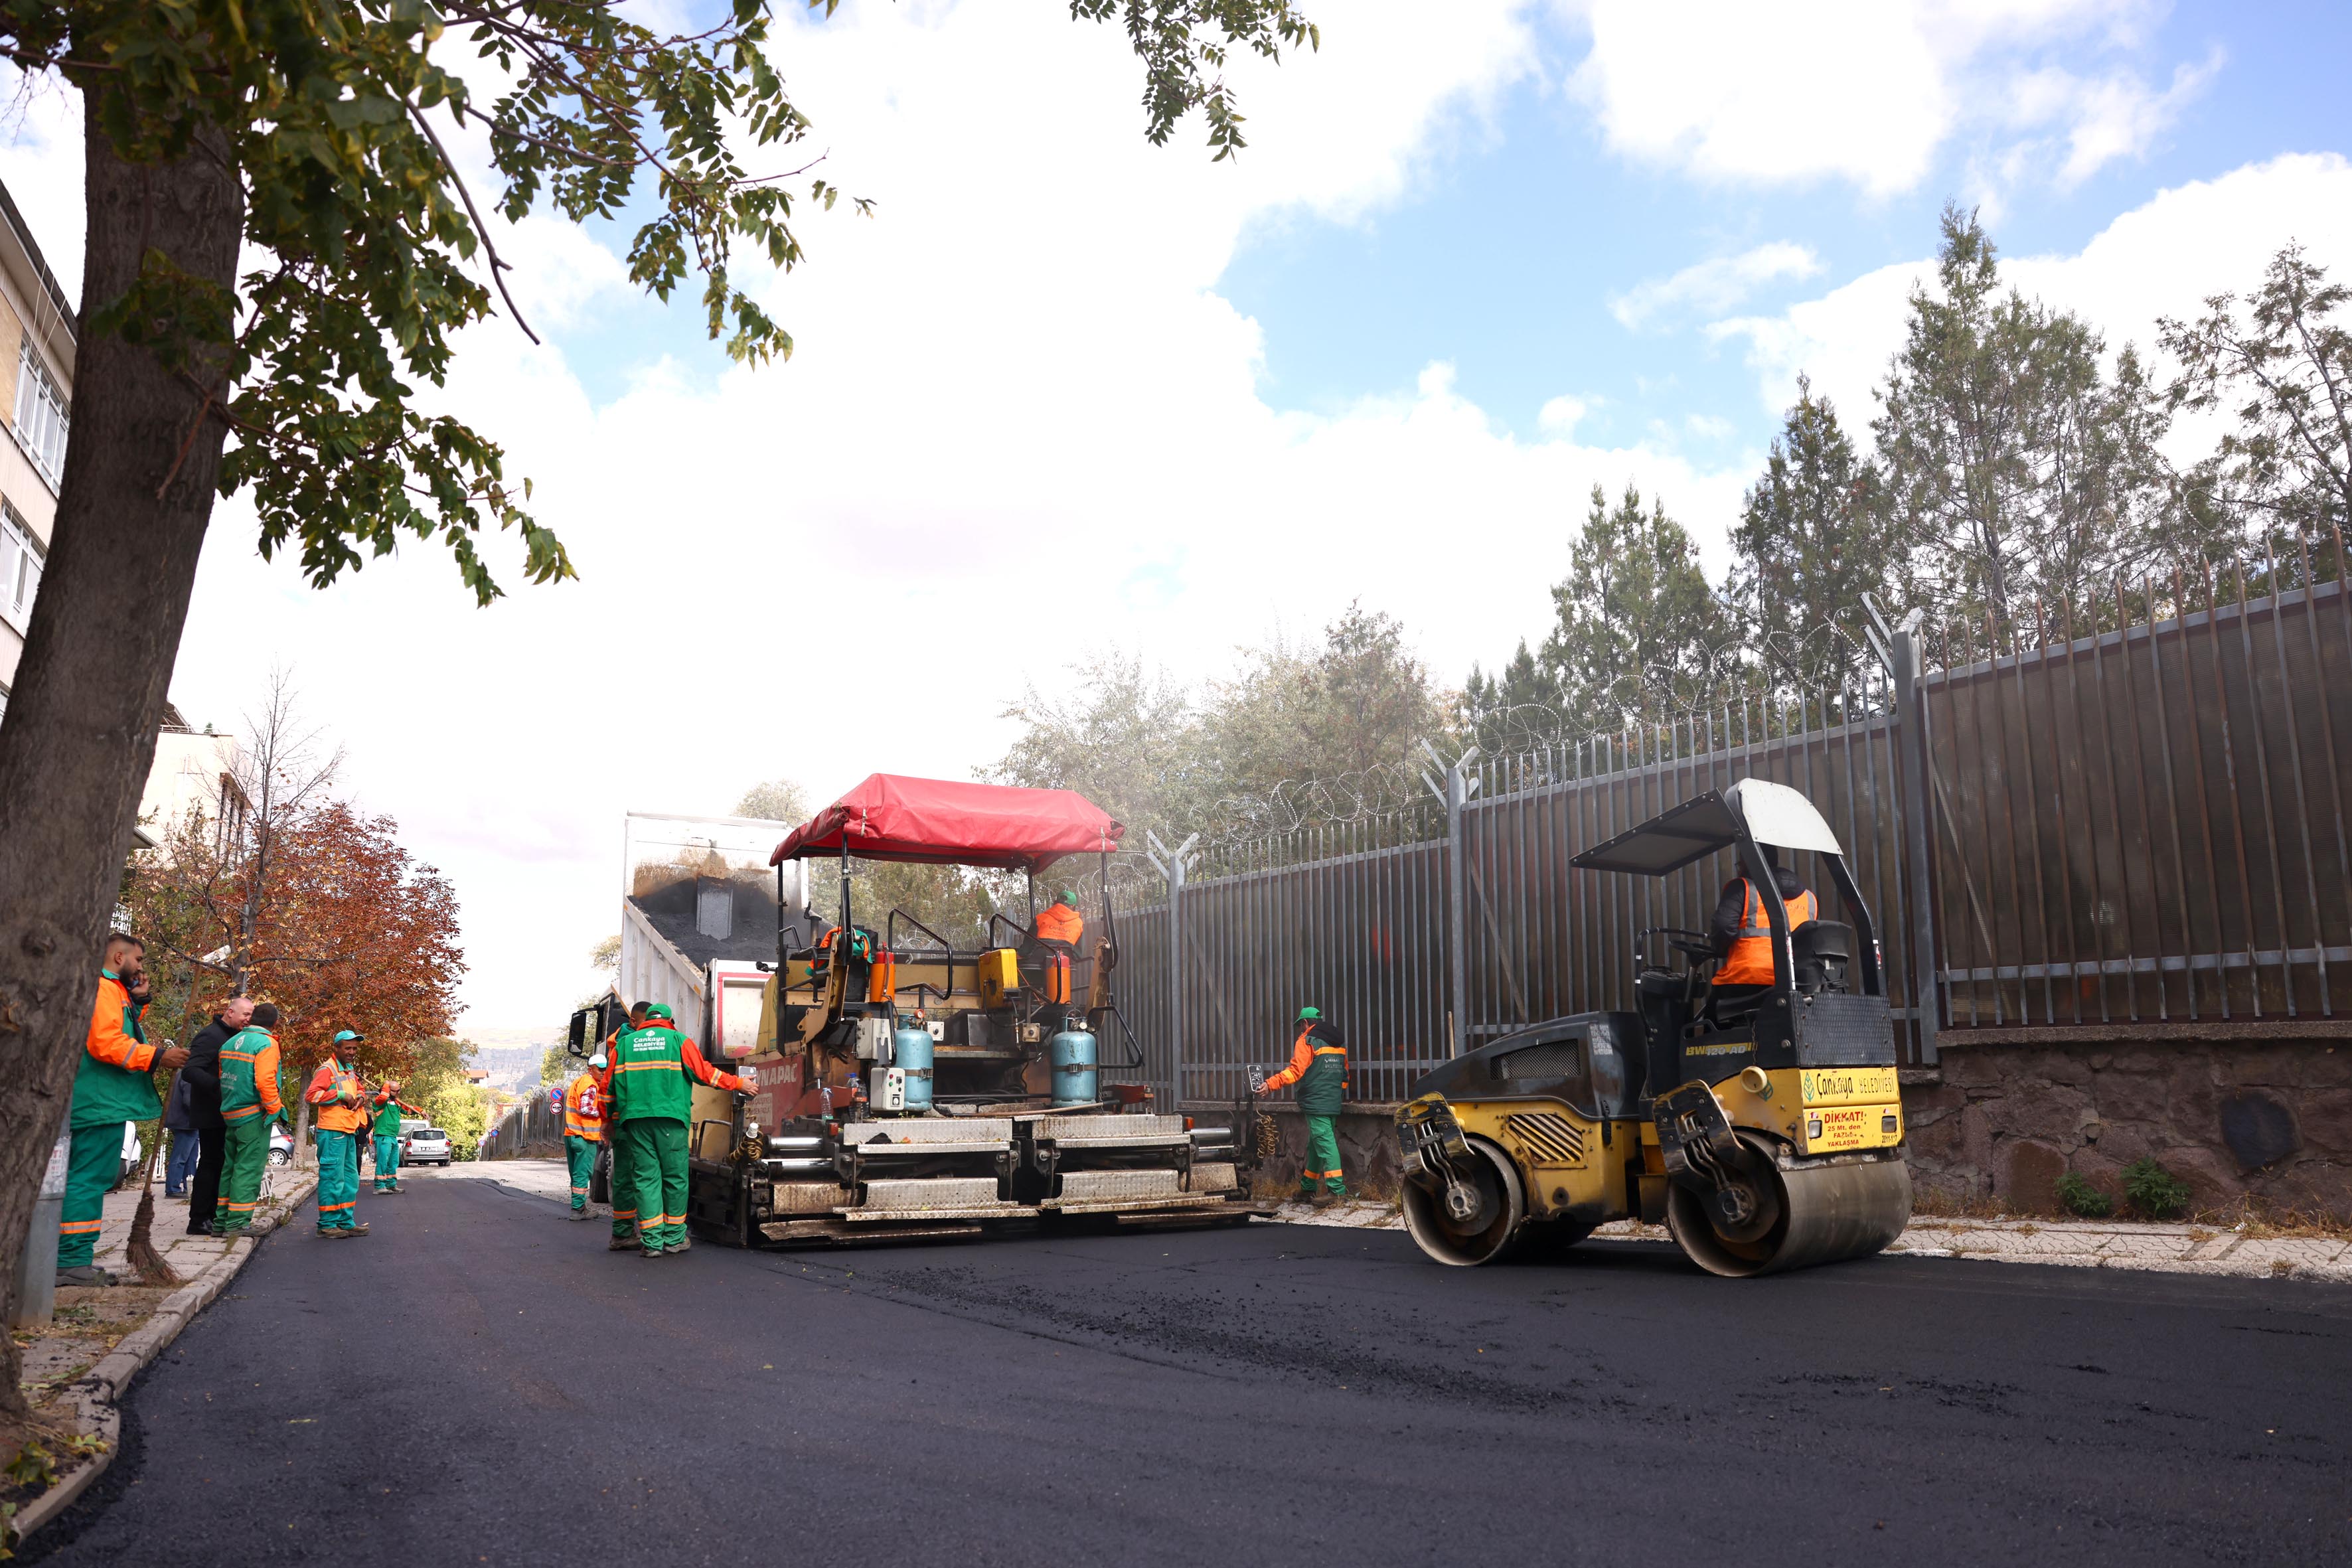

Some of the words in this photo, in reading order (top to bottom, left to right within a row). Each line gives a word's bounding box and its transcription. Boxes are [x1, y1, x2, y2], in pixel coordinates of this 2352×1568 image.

[756, 1063, 797, 1087] YNAPAC
[1817, 1073, 1853, 1099] Çankaya
[1825, 1111, 1863, 1123] DİKKAT!
